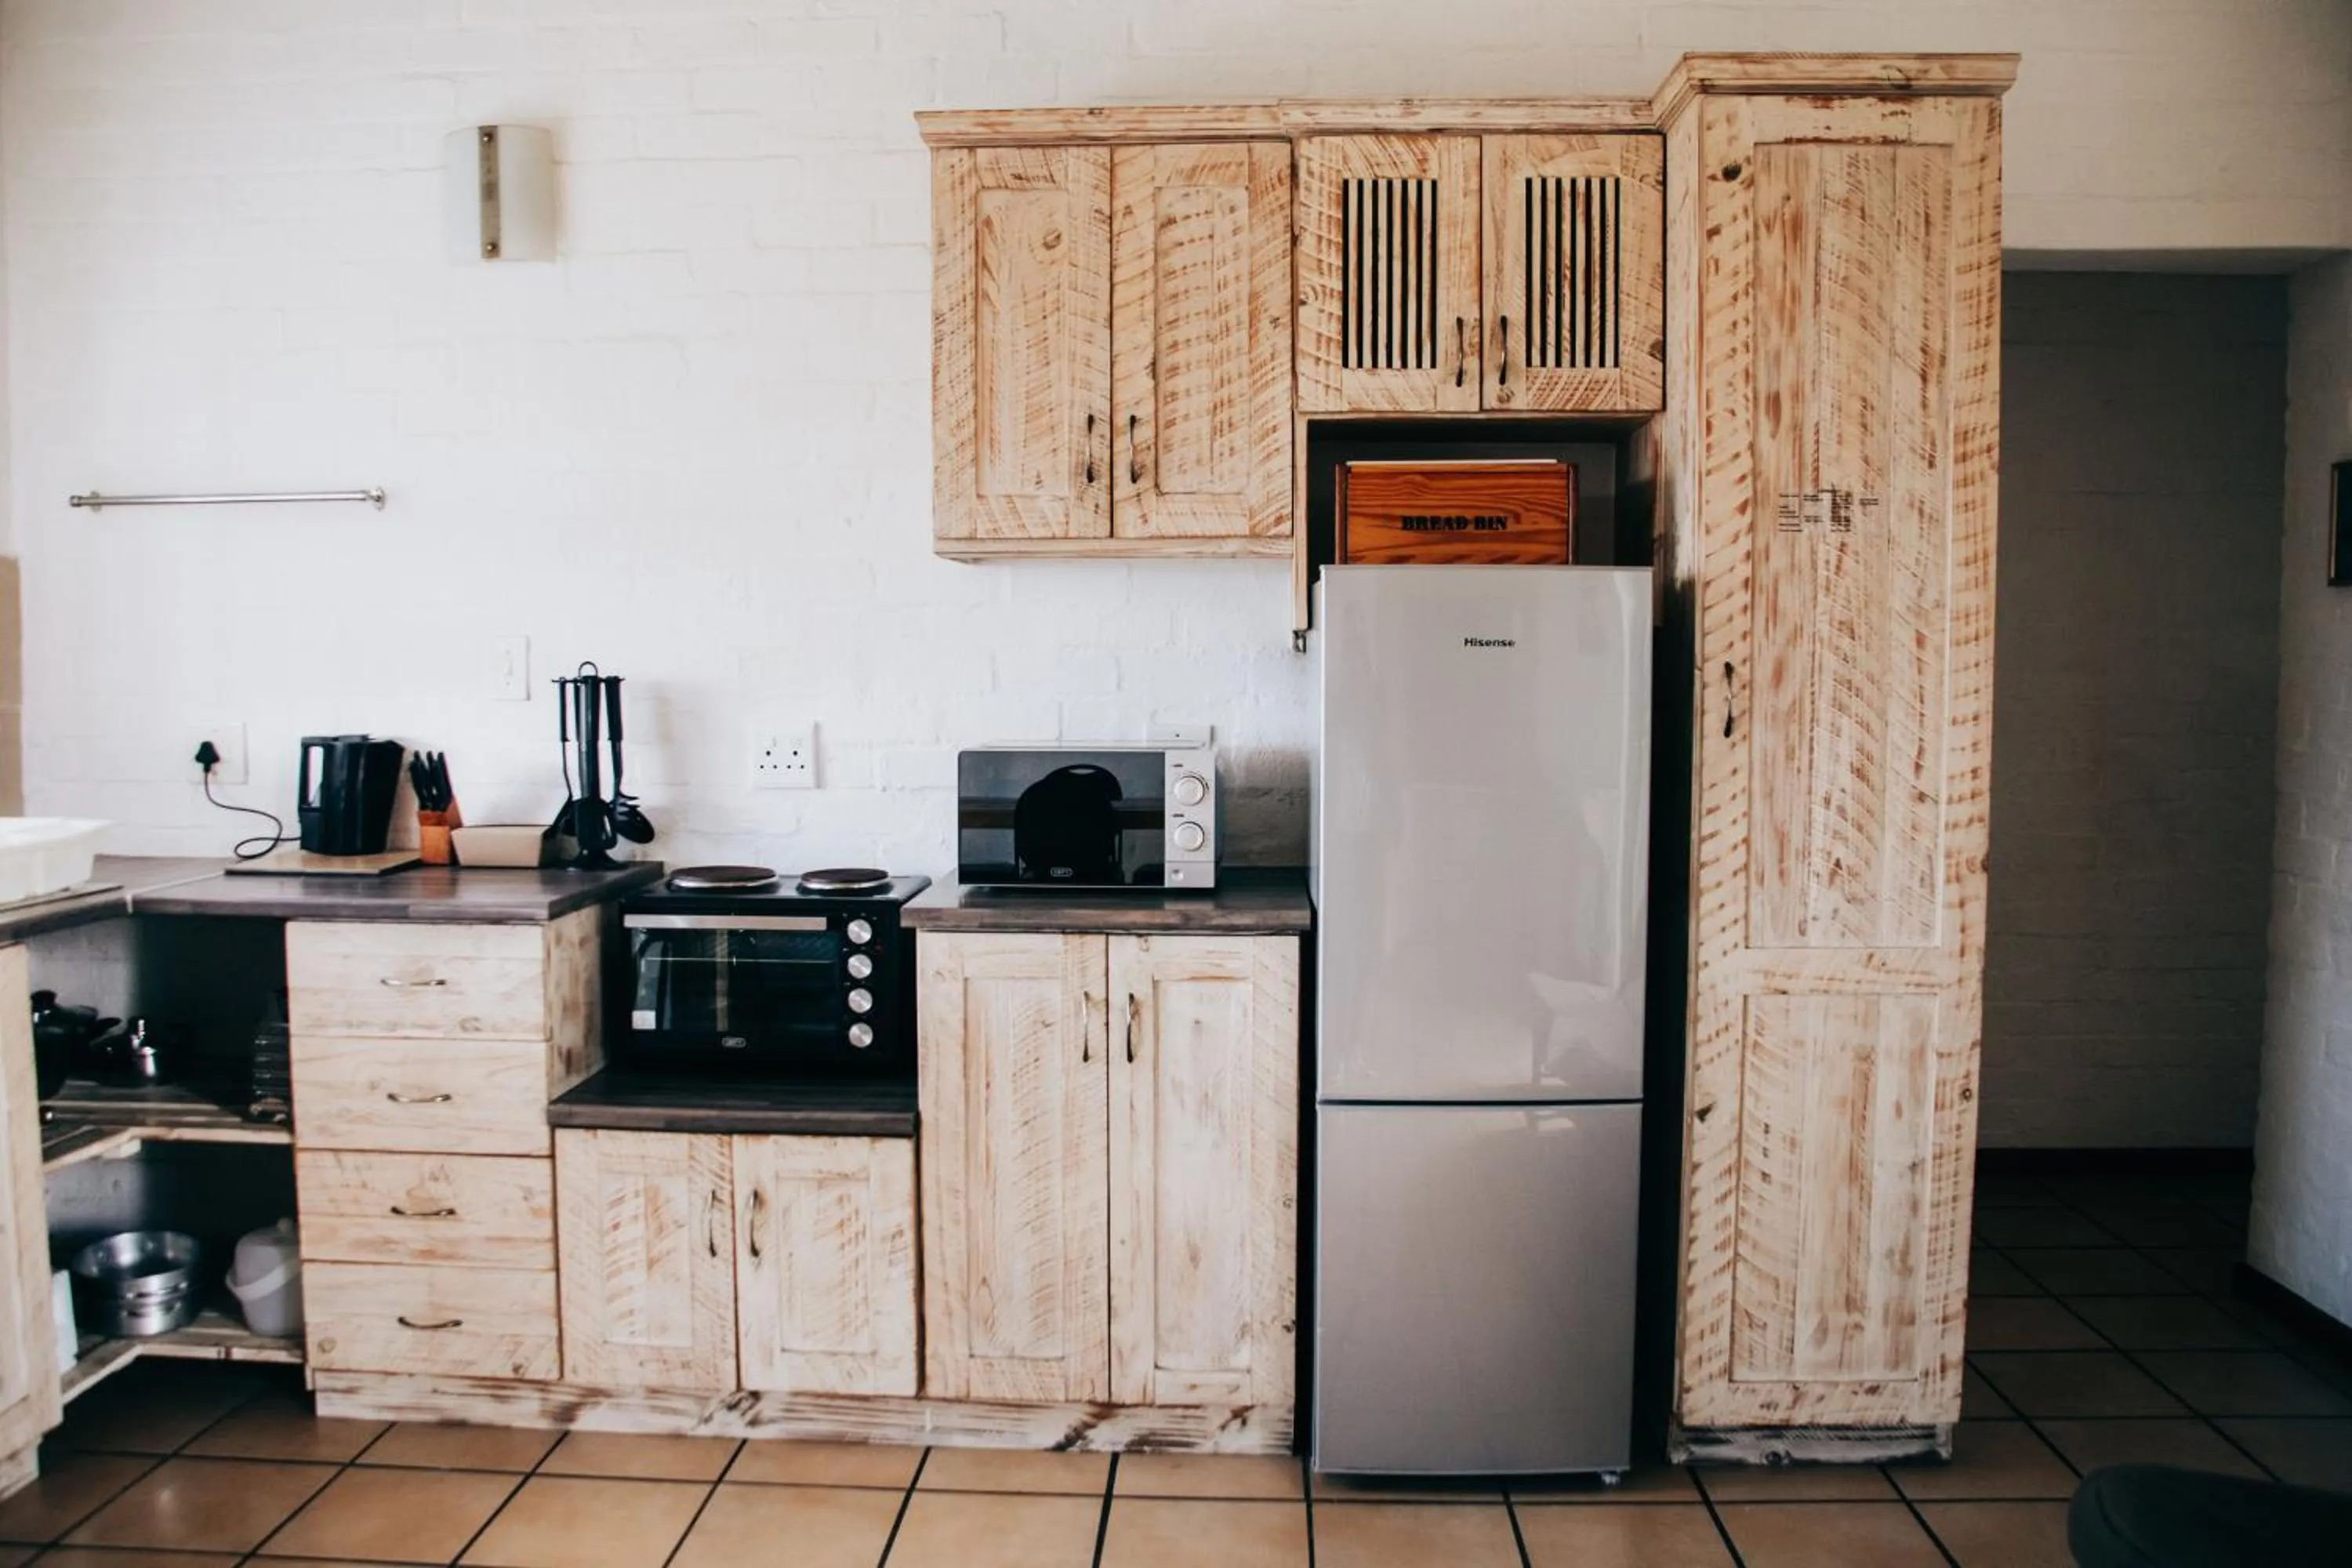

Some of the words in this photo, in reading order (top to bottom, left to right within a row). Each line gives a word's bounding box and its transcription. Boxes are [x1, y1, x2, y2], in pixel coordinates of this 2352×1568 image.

[1401, 516, 1468, 530] BREAD
[1475, 516, 1507, 530] BIN
[1464, 637, 1515, 647] Hisense
